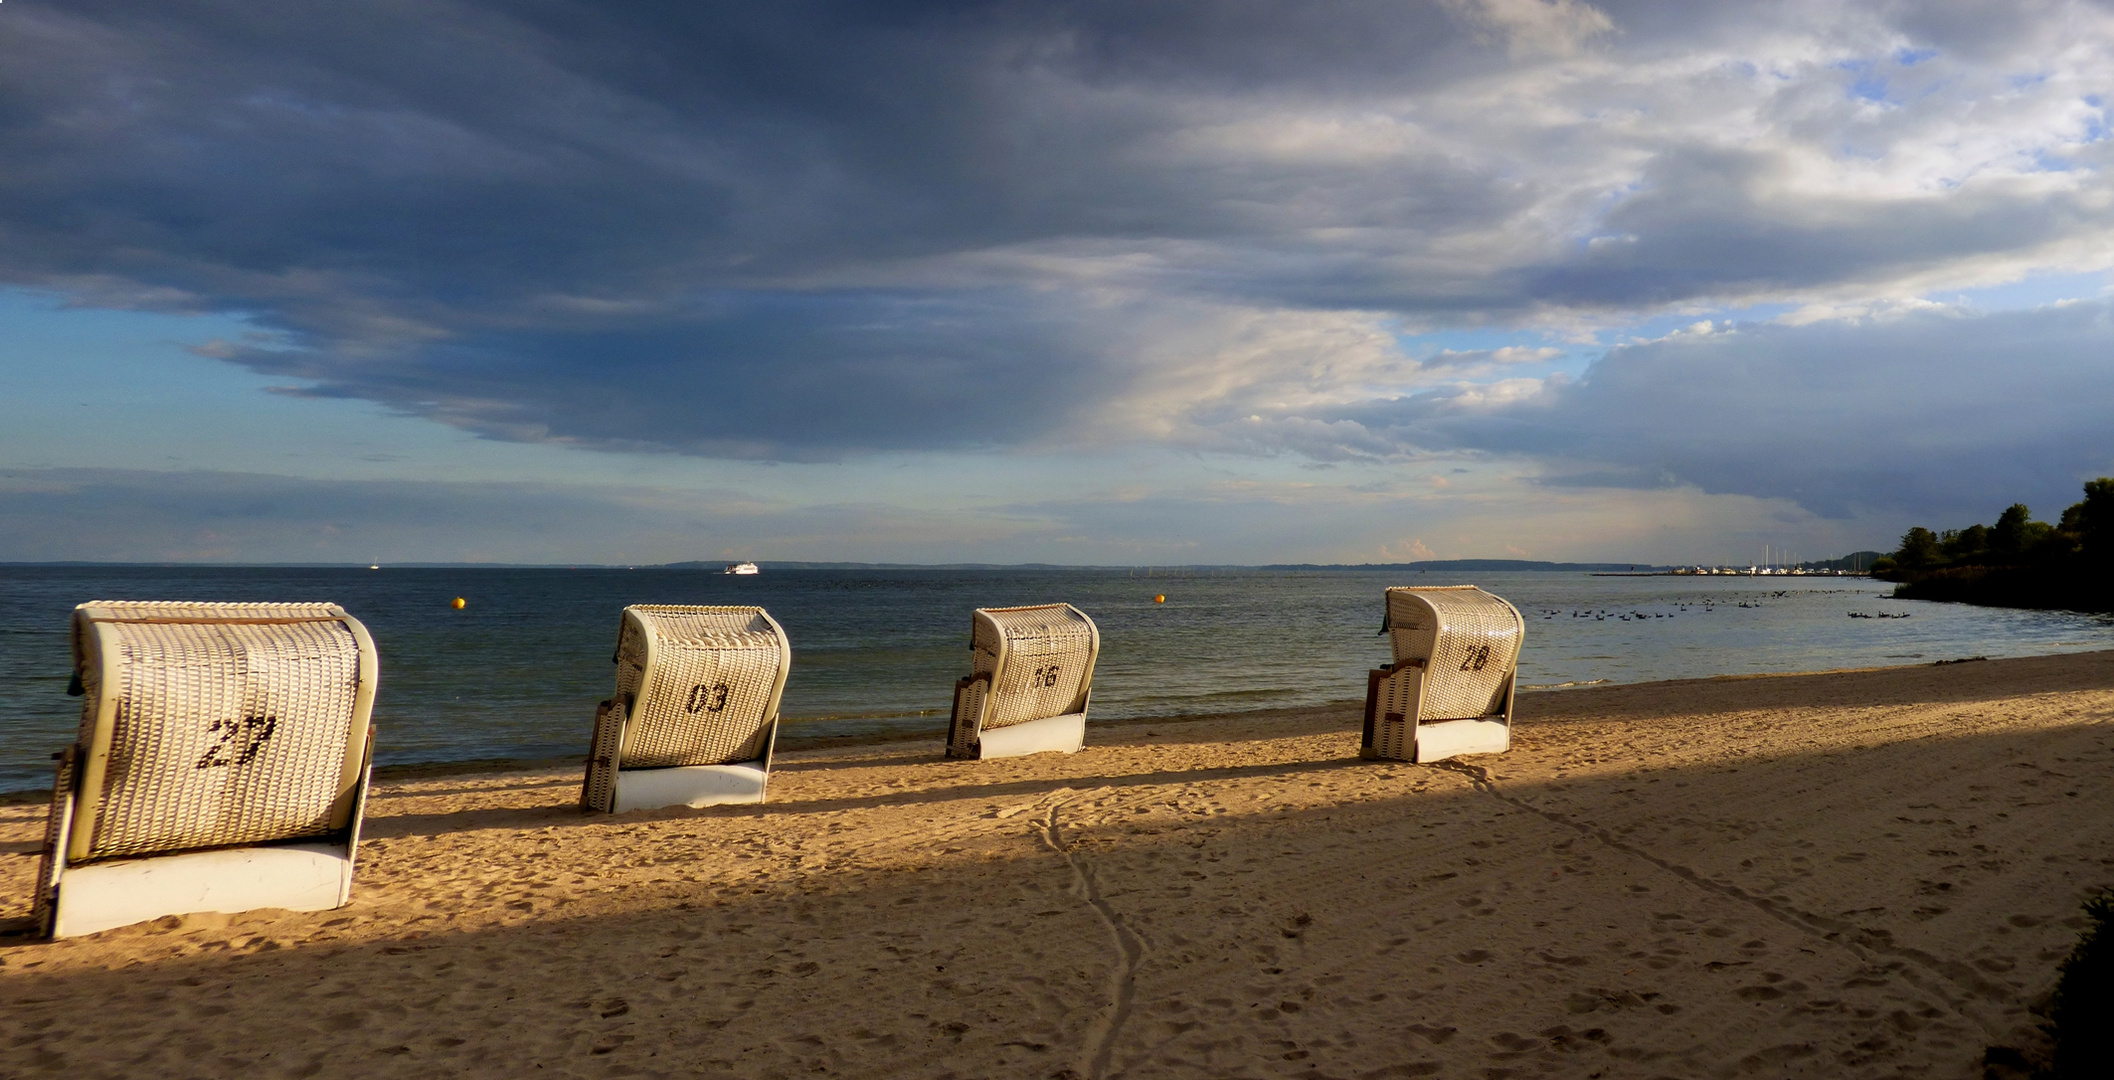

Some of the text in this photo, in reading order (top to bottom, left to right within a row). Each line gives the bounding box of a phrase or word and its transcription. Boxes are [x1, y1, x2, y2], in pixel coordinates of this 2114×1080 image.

[1459, 645, 1490, 671] 28
[1034, 665, 1059, 688] 16
[686, 684, 729, 714] 03
[196, 715, 277, 769] 27
